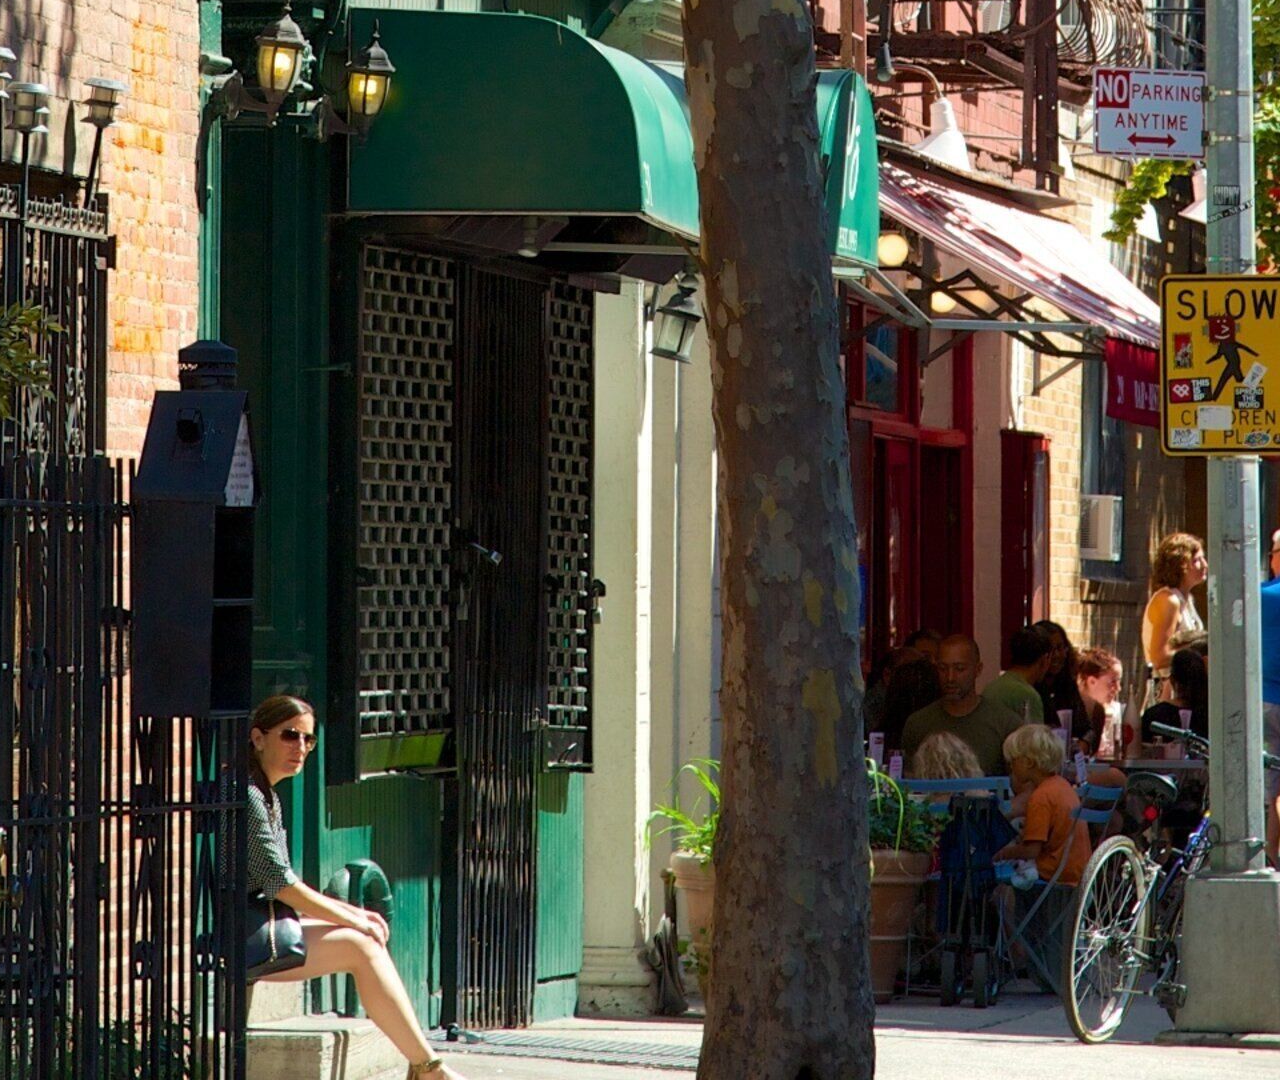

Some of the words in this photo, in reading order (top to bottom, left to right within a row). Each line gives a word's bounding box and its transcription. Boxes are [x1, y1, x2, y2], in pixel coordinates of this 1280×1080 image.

[1099, 74, 1128, 103] NO
[1132, 84, 1201, 102] PARKING
[1115, 113, 1189, 131] ANYTIME
[1177, 289, 1277, 320] SLOW
[1192, 379, 1210, 388] THIS
